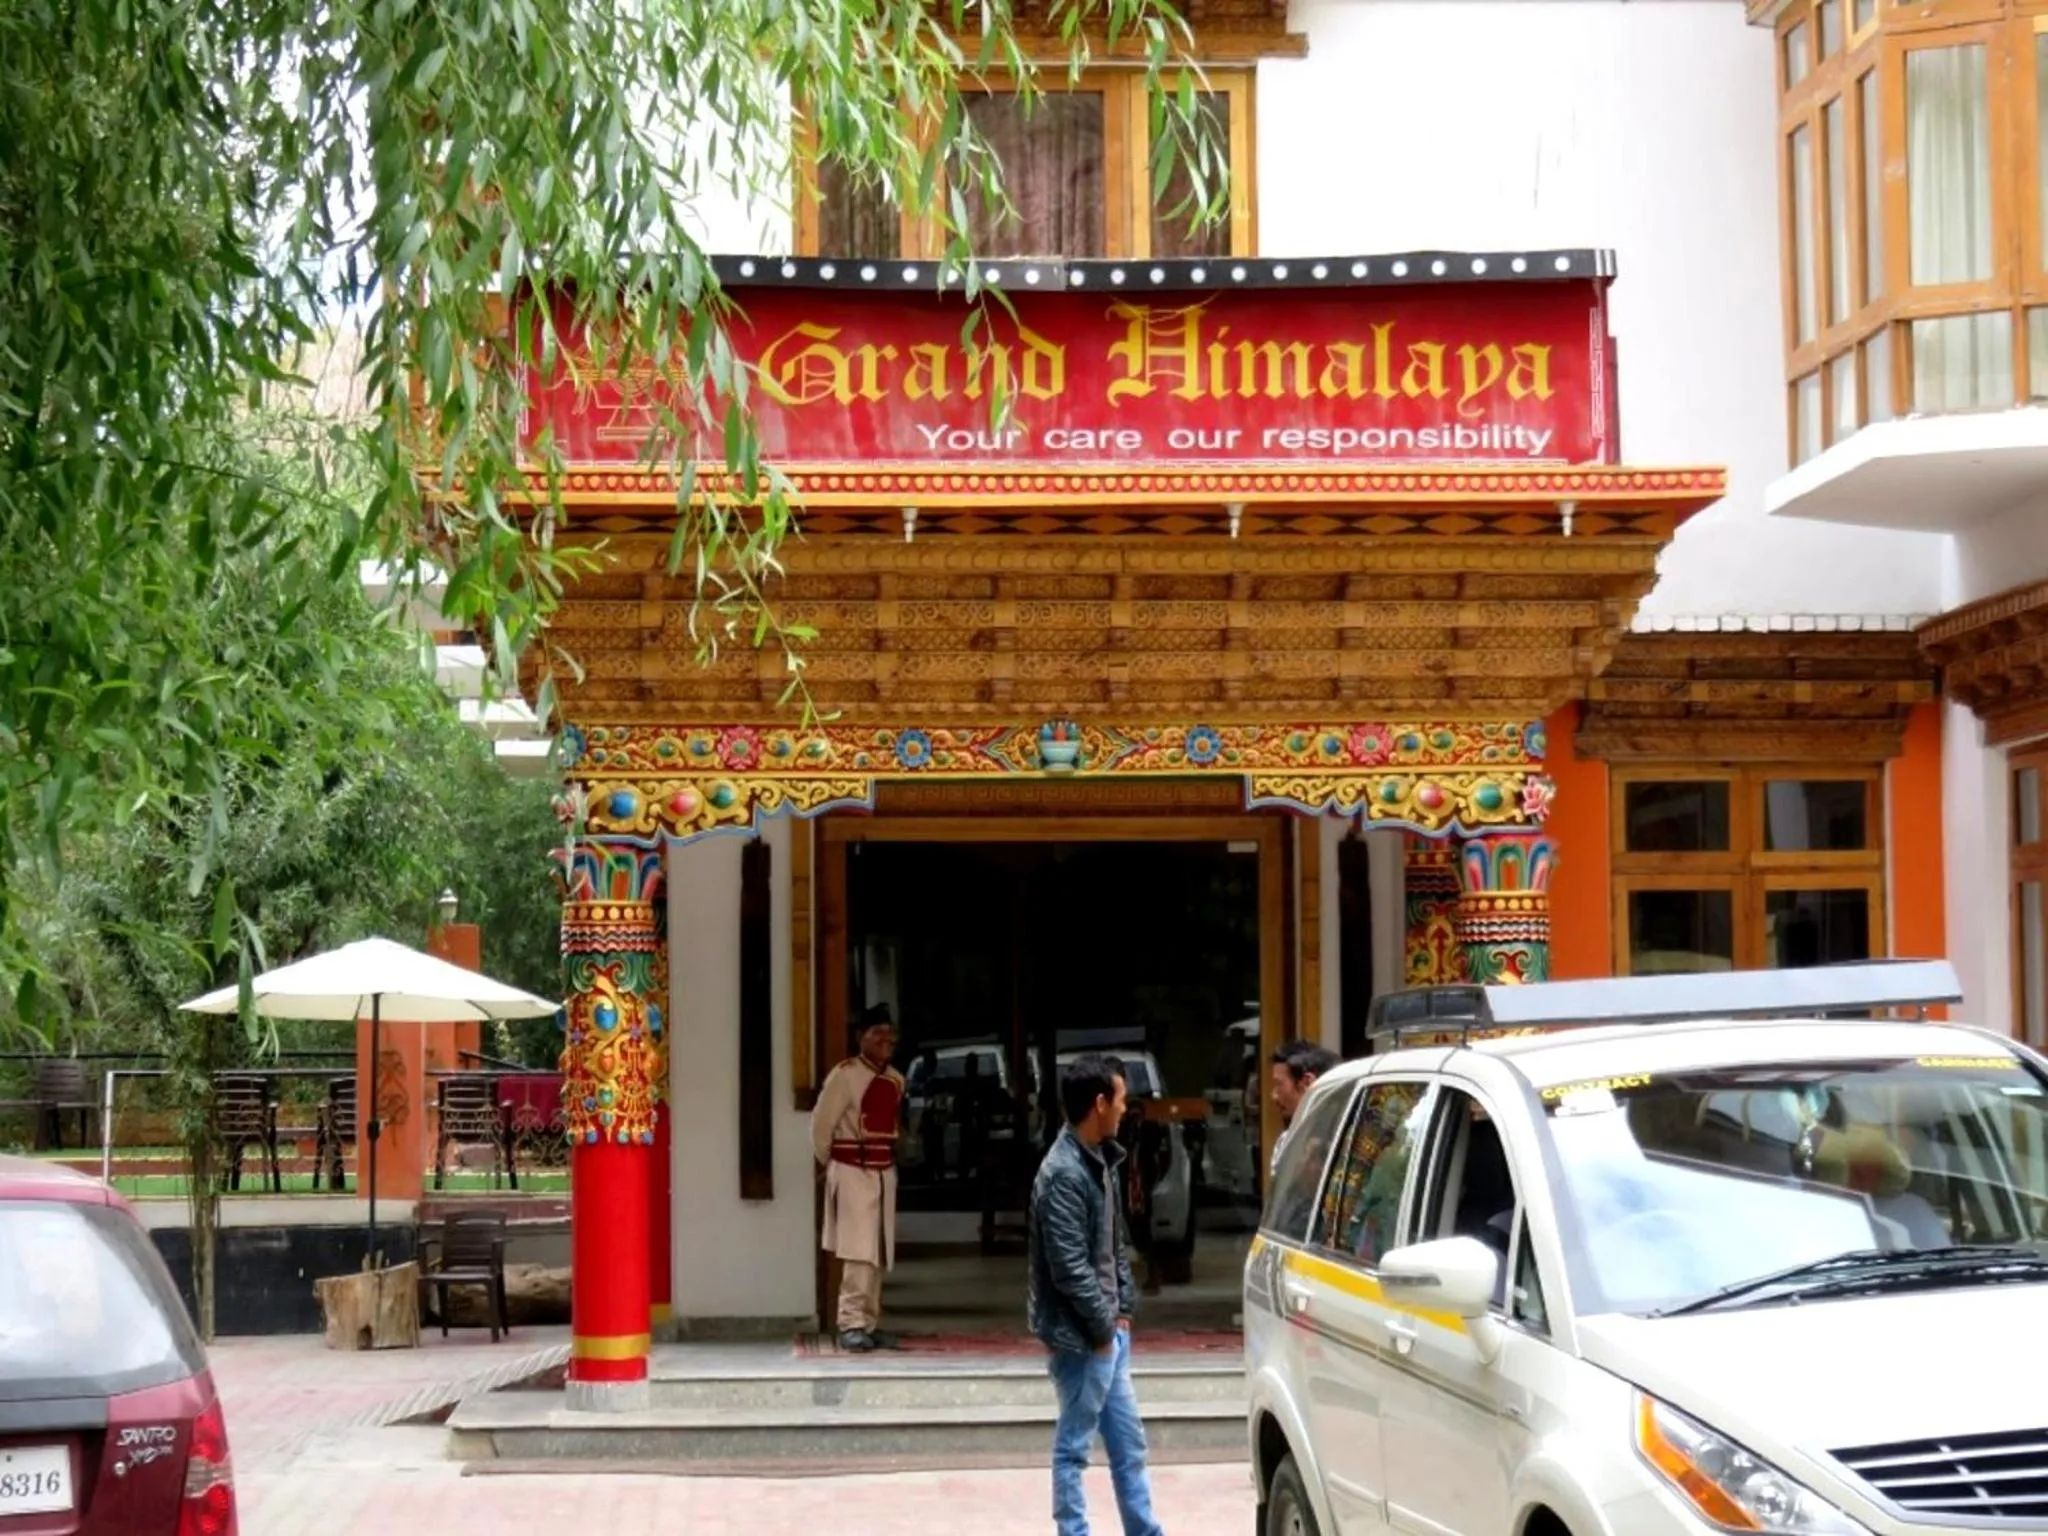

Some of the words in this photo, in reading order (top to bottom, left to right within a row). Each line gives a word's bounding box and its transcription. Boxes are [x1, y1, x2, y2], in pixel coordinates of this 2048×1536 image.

[759, 322, 1066, 405] Grand
[1106, 304, 1556, 418] Himalaya
[917, 424, 1023, 451] Your
[1043, 429, 1142, 451] care
[1168, 429, 1242, 450] our
[1263, 426, 1552, 455] responsibility
[117, 1426, 176, 1446] SANTRO
[0, 1471, 60, 1498] 8316
